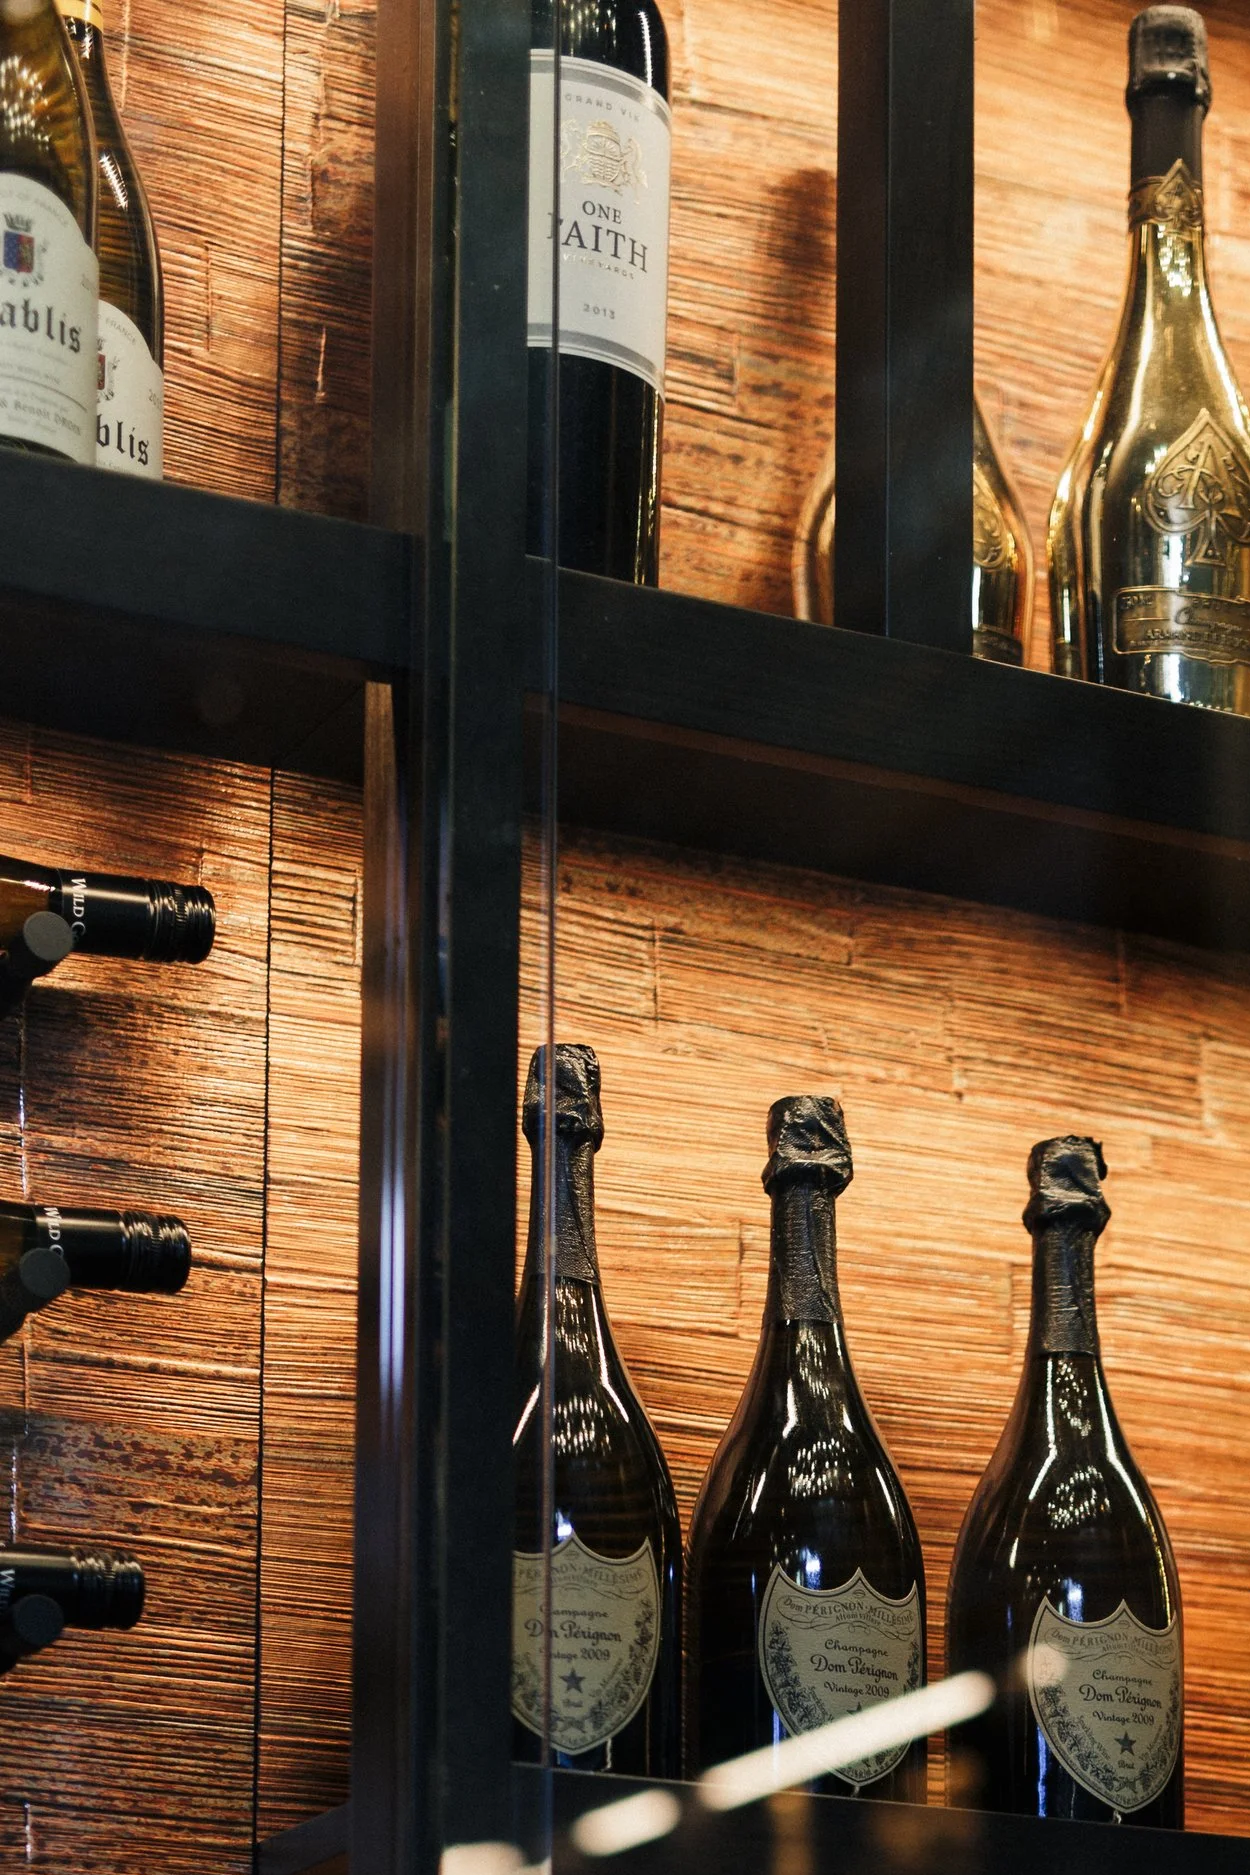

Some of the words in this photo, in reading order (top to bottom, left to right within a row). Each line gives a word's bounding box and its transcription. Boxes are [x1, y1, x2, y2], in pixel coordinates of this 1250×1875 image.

[564, 92, 613, 112] GRAND
[581, 200, 623, 225] ONE
[582, 303, 617, 321] 2013
[71, 878, 87, 918] WILD
[43, 1206, 63, 1241] WILD
[540, 1605, 609, 1621] Campagne
[524, 1619, 558, 1638] Dm
[560, 1619, 623, 1646] Pérignon
[581, 1648, 610, 1662] 2009
[824, 1638, 889, 1659] Champagne
[810, 1654, 846, 1673] Dom
[848, 1656, 899, 1682] Pérignon
[1092, 1668, 1153, 1686] Champagne
[823, 1680, 864, 1696] Vintage
[865, 1684, 890, 1698] 2009
[1079, 1683, 1114, 1703] Dom
[1115, 1685, 1163, 1712] Pérignon
[1092, 1710, 1130, 1726] Vintage
[1131, 1712, 1155, 1726] 2009
